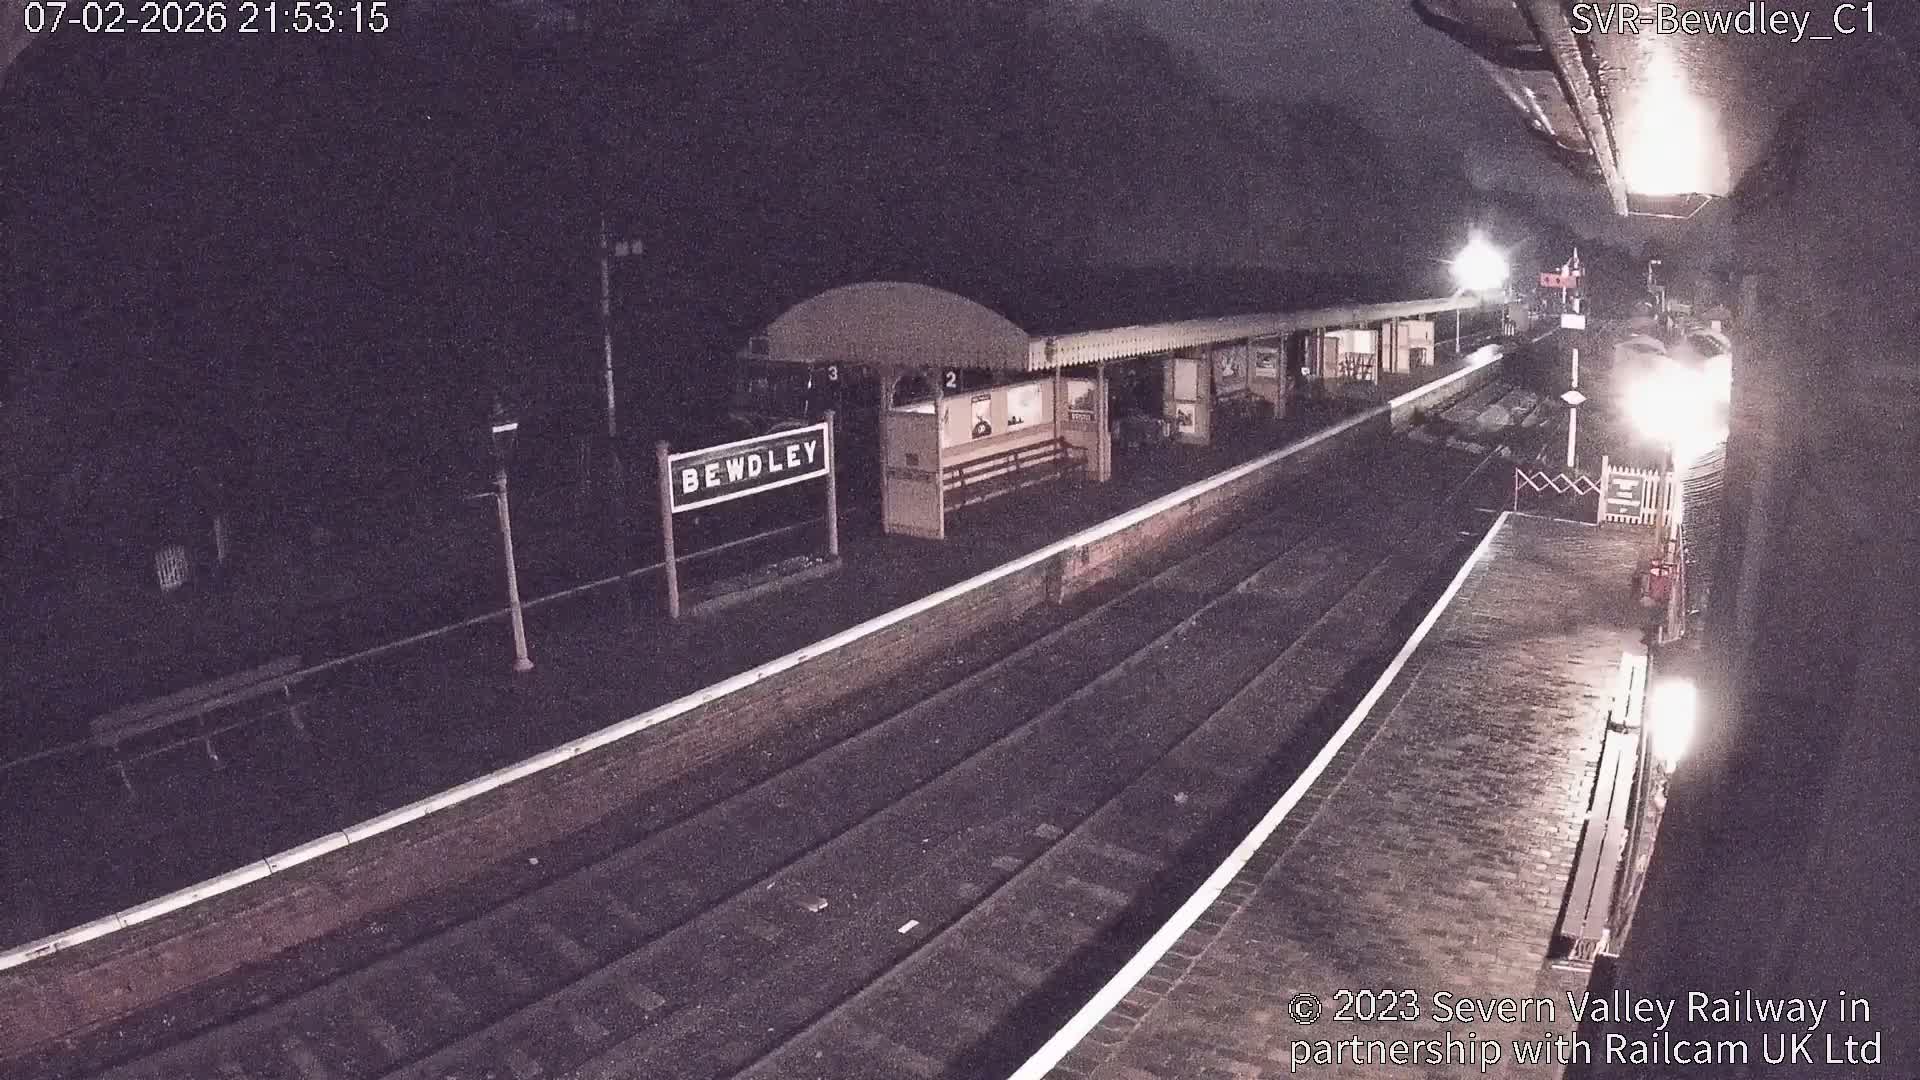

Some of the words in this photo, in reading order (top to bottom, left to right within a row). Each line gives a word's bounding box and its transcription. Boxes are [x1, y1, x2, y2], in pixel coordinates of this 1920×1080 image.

[828, 366, 839, 381] 3
[946, 371, 956, 388] 2
[681, 439, 817, 494] BEWDLEY
